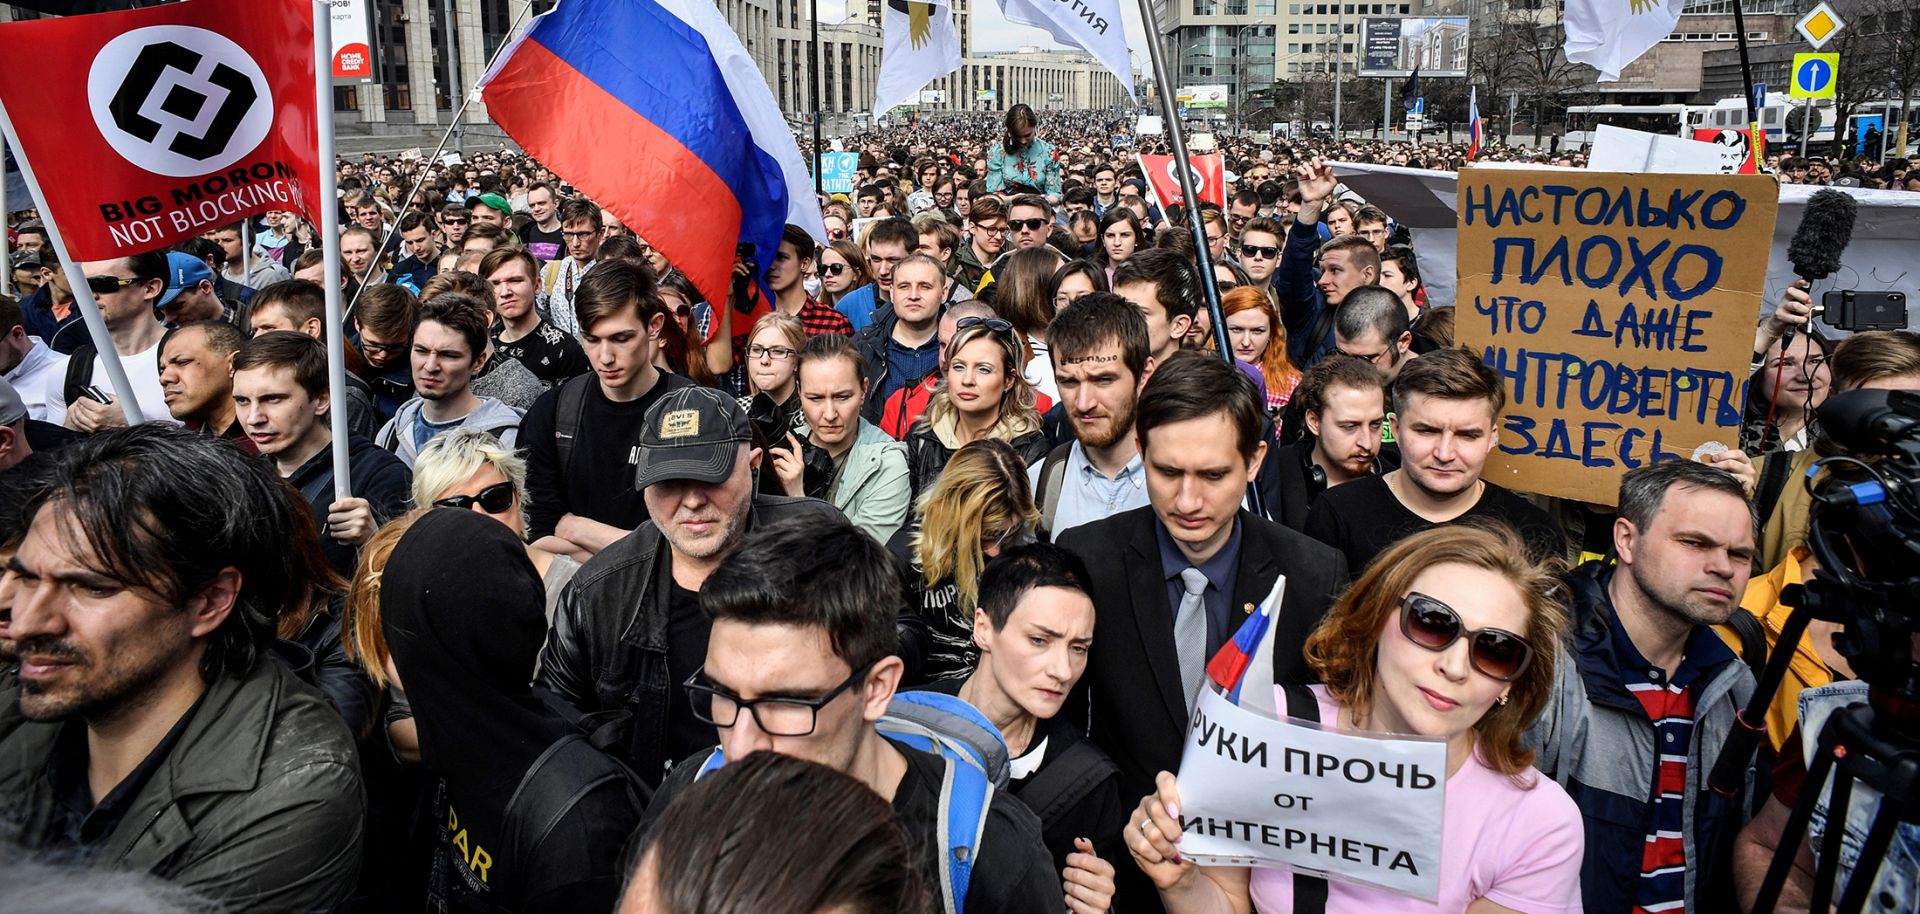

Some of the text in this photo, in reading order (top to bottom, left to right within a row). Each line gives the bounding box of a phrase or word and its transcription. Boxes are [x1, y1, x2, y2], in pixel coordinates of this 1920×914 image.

[99, 196, 163, 223] BIG
[109, 216, 164, 247] NOT
[169, 180, 289, 233] BLOCKING
[1465, 183, 1747, 230] НАСТОЛЬКО
[1490, 234, 1723, 301] ПЛОХО
[1474, 295, 1713, 352] ЧТО ДАЖЕ
[1498, 414, 1683, 469] ЗДЕСЬ
[1190, 706, 1437, 790] РУКИ ПРОЧЬ
[1178, 814, 1419, 877] ИНТЕРНЕТА
